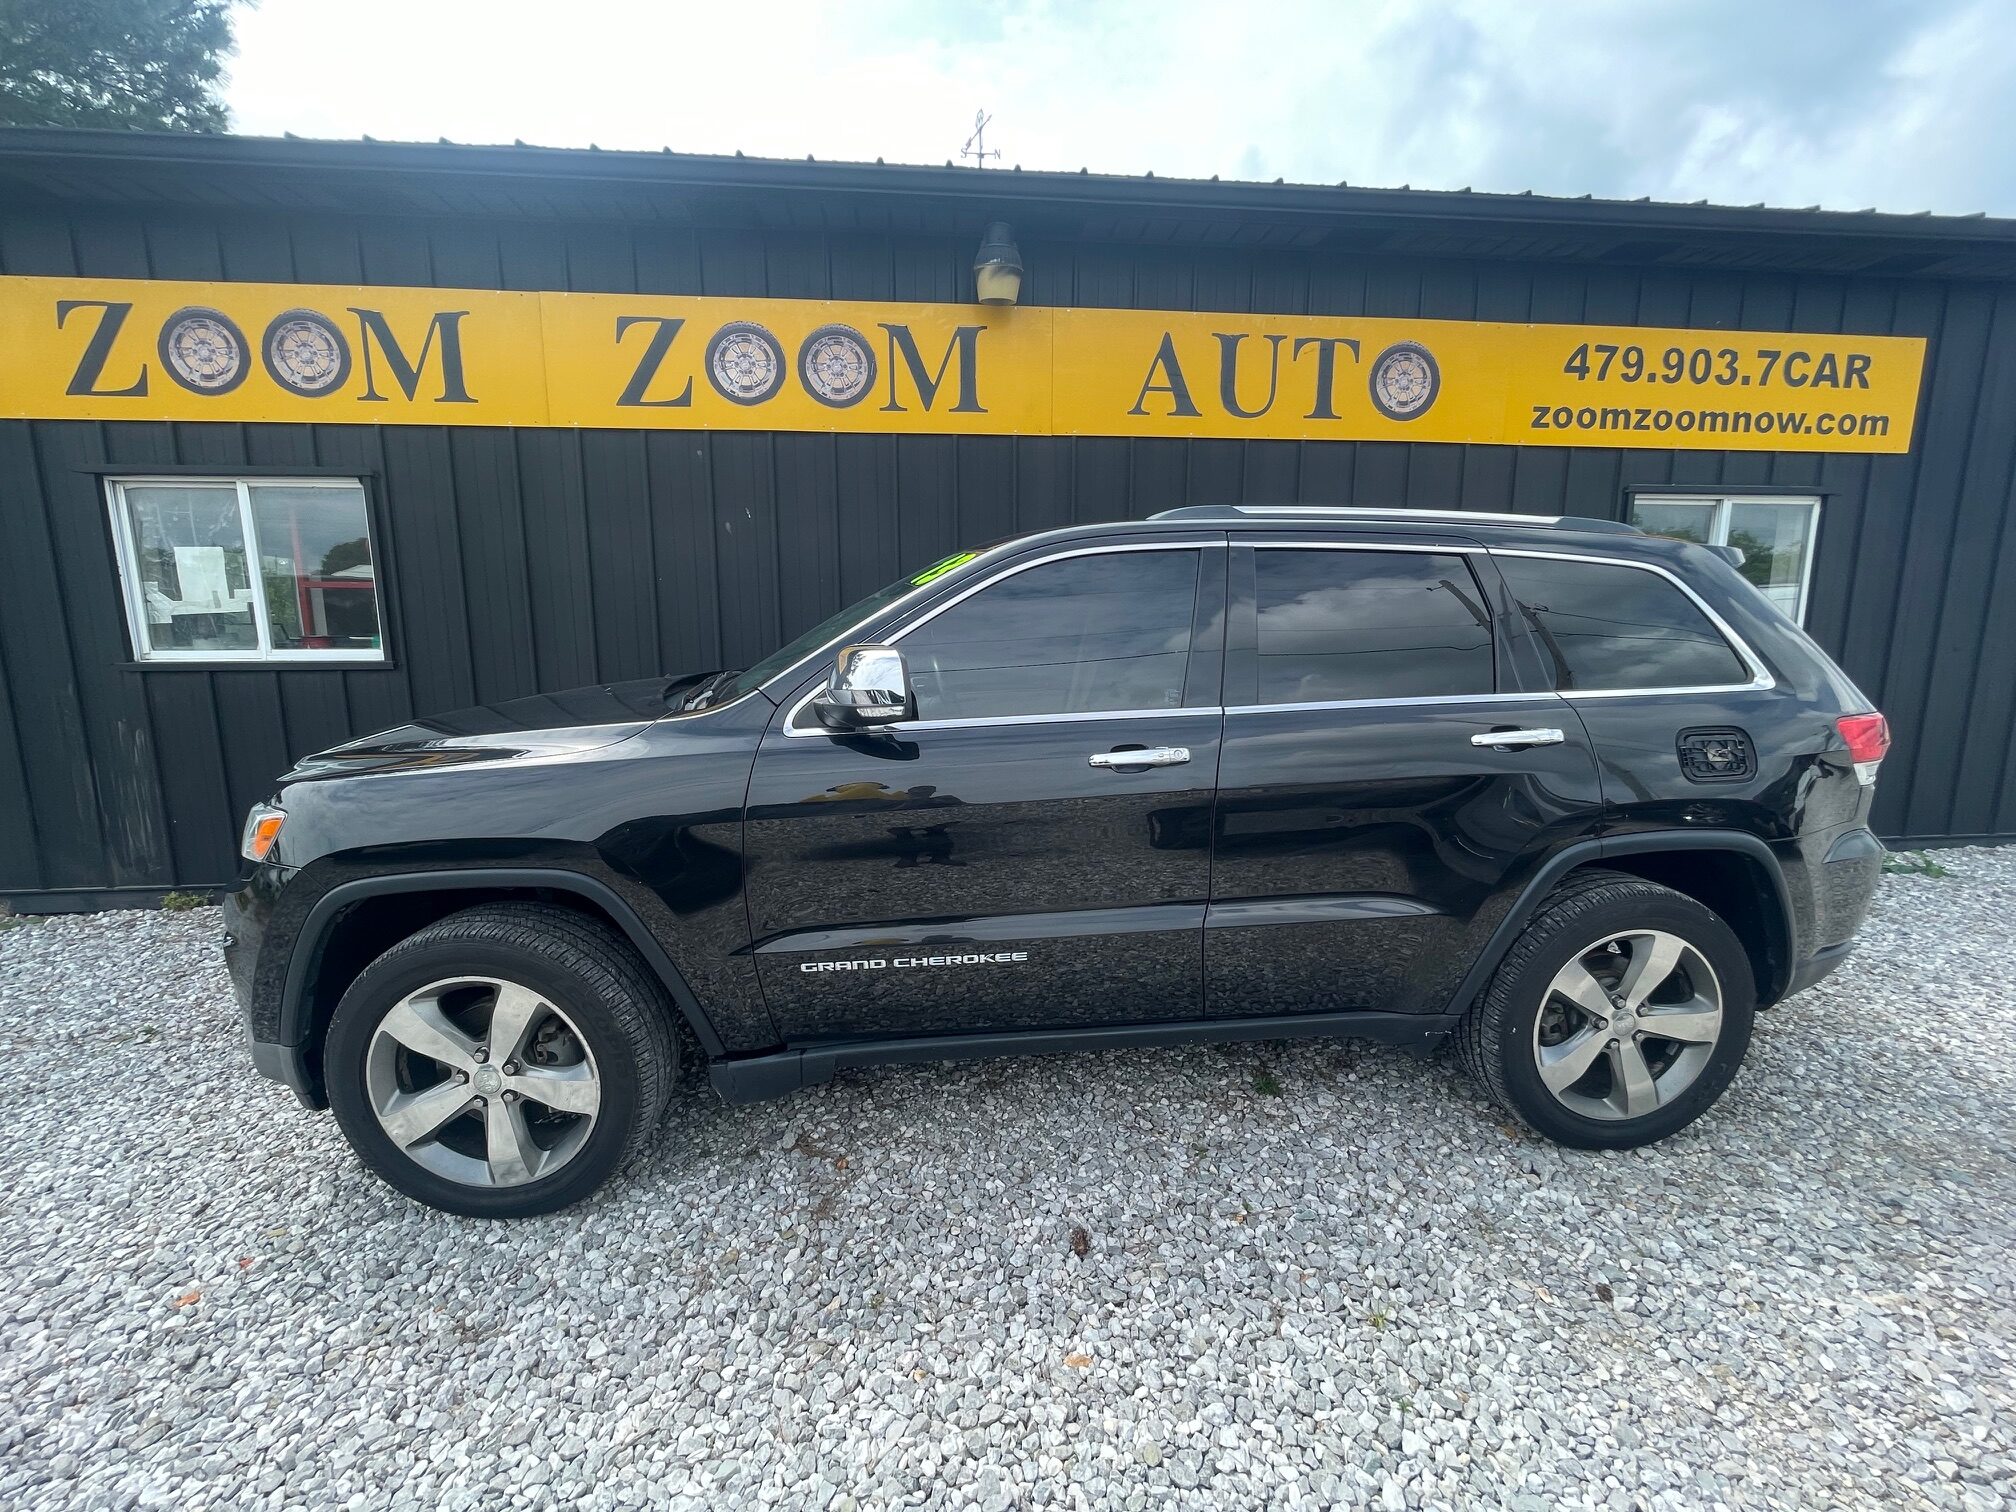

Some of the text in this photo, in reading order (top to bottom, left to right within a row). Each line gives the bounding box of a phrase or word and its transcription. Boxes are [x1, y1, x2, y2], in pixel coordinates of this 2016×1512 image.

[994, 148, 1001, 160] N
[57, 300, 1441, 421] ZOOM ZOOM AUTO
[1563, 343, 1872, 389] 479.903.7CAR
[1531, 405, 1890, 436] zoomzoomnow.com
[800, 951, 1028, 973] GRAND CHEROKEE
